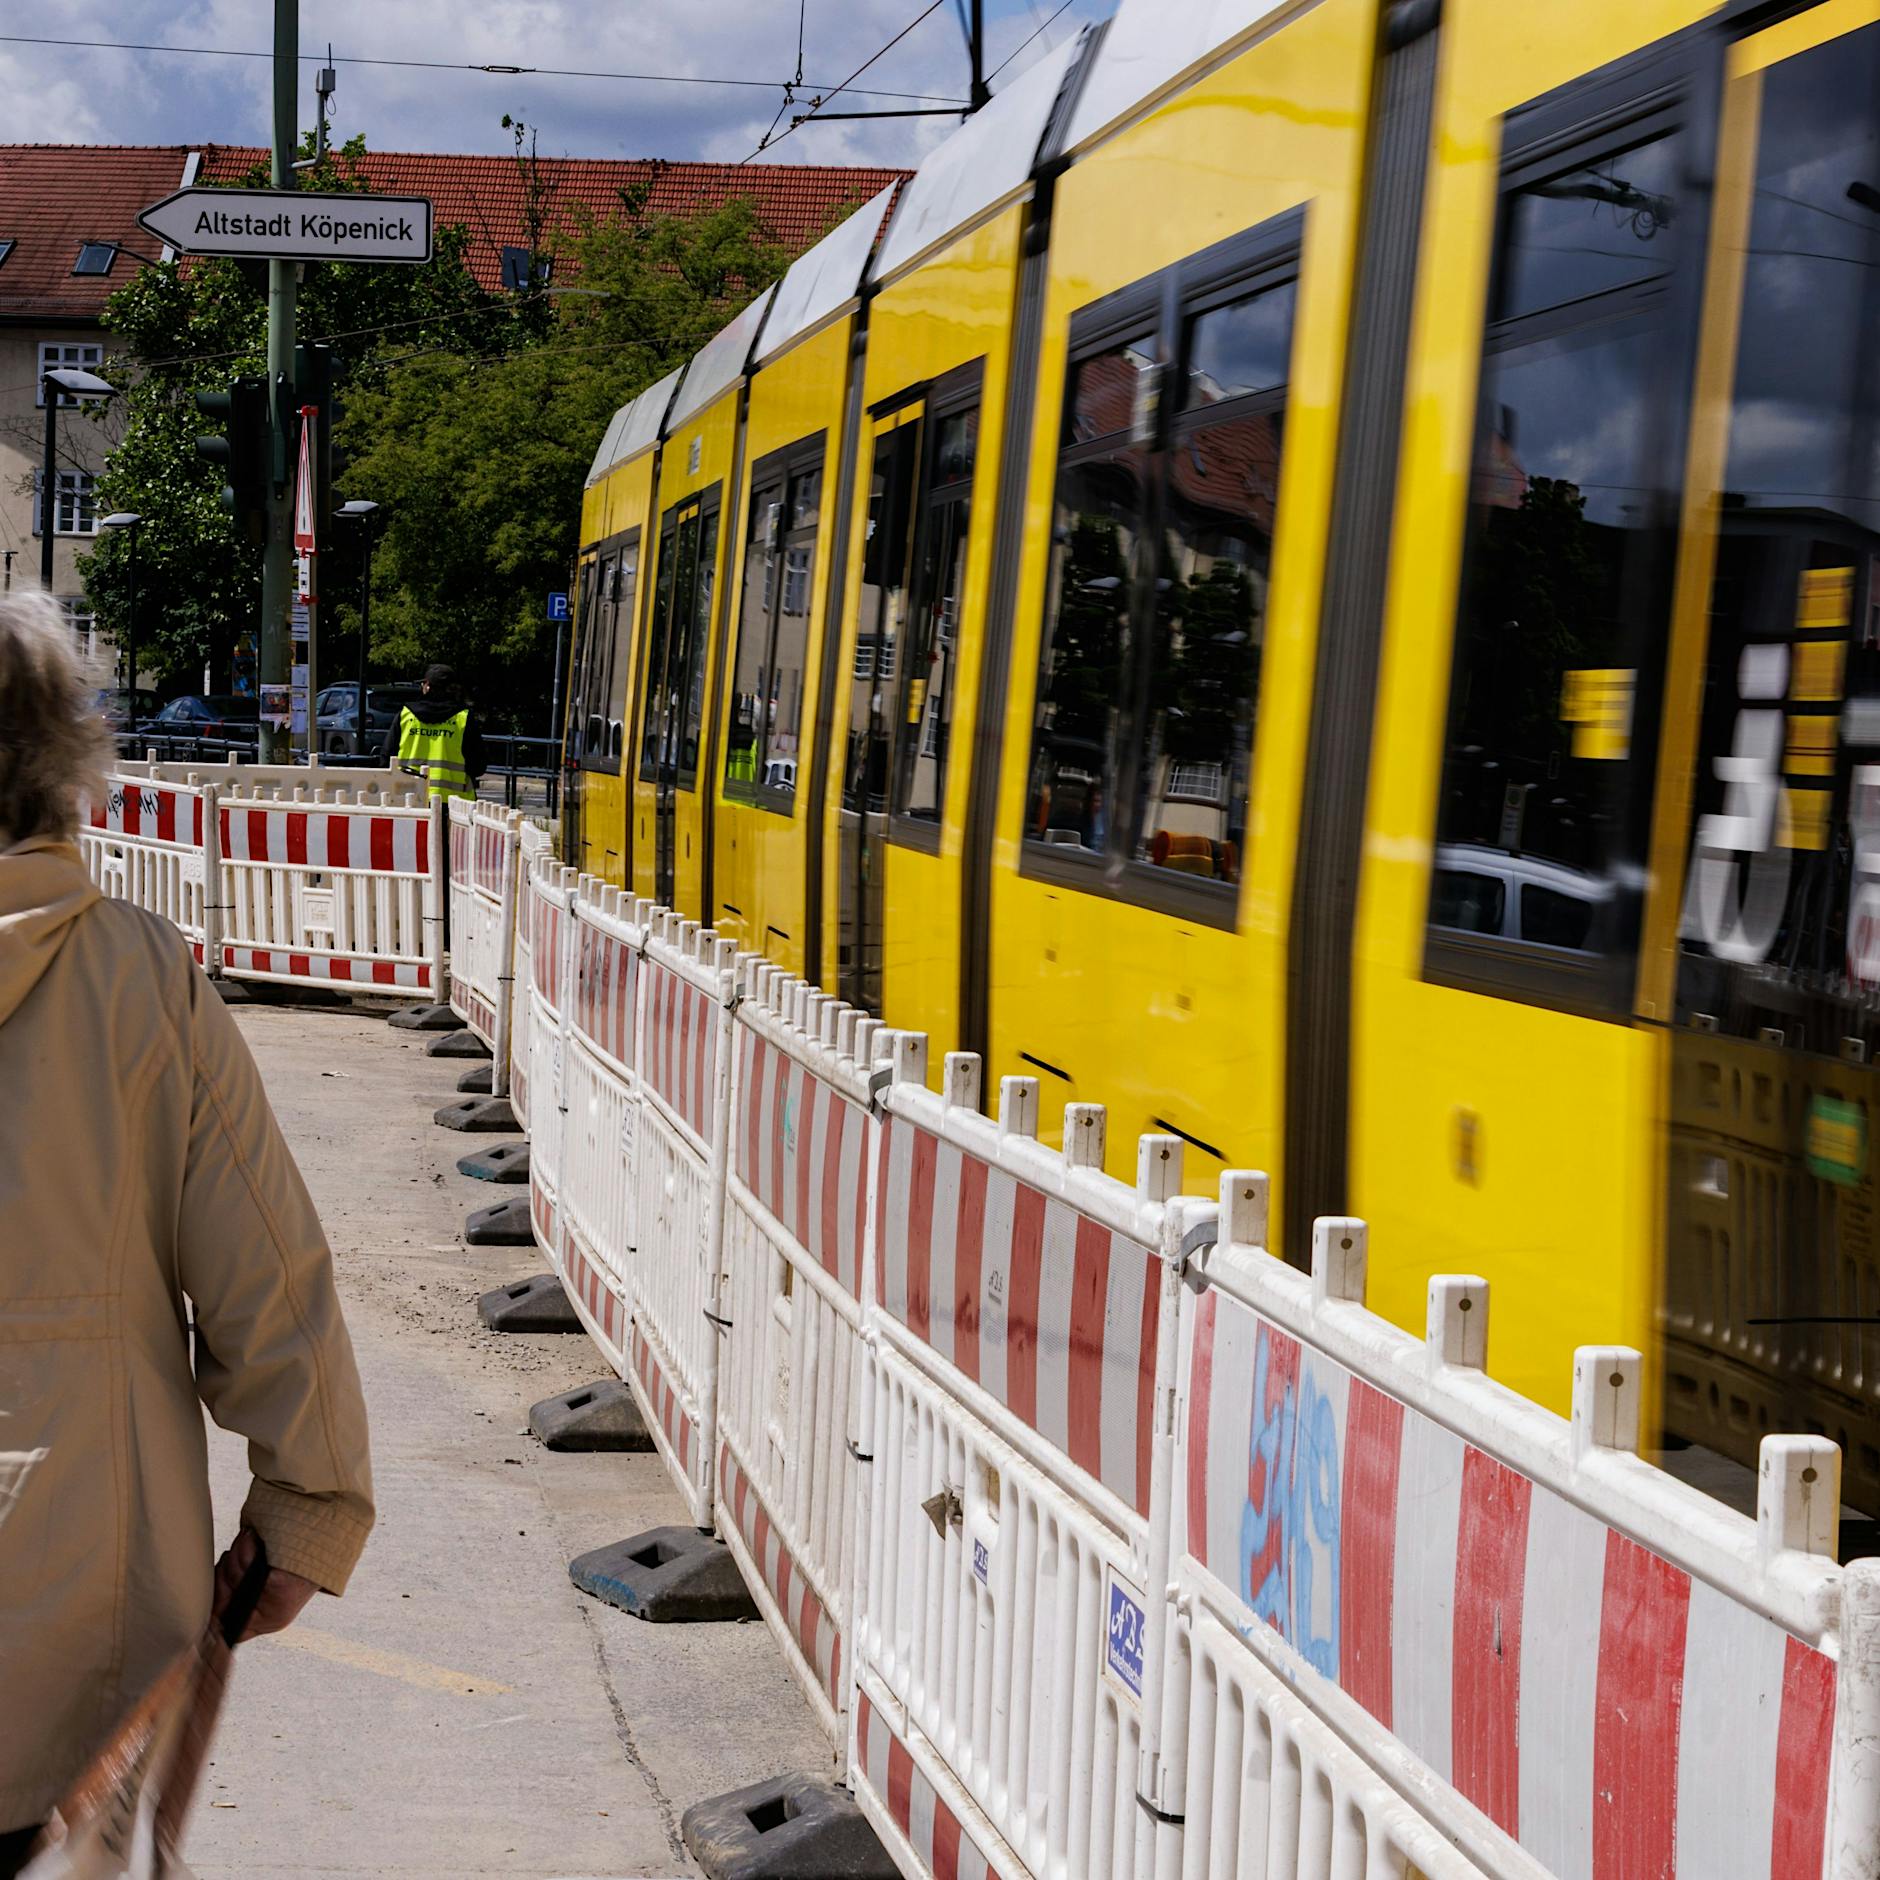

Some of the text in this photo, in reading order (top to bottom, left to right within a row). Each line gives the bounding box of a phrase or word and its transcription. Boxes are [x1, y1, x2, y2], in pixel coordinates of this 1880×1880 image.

[194, 211, 413, 244] Altstadt Köpenick
[554, 596, 567, 617] P
[409, 727, 455, 739] SECURITY
